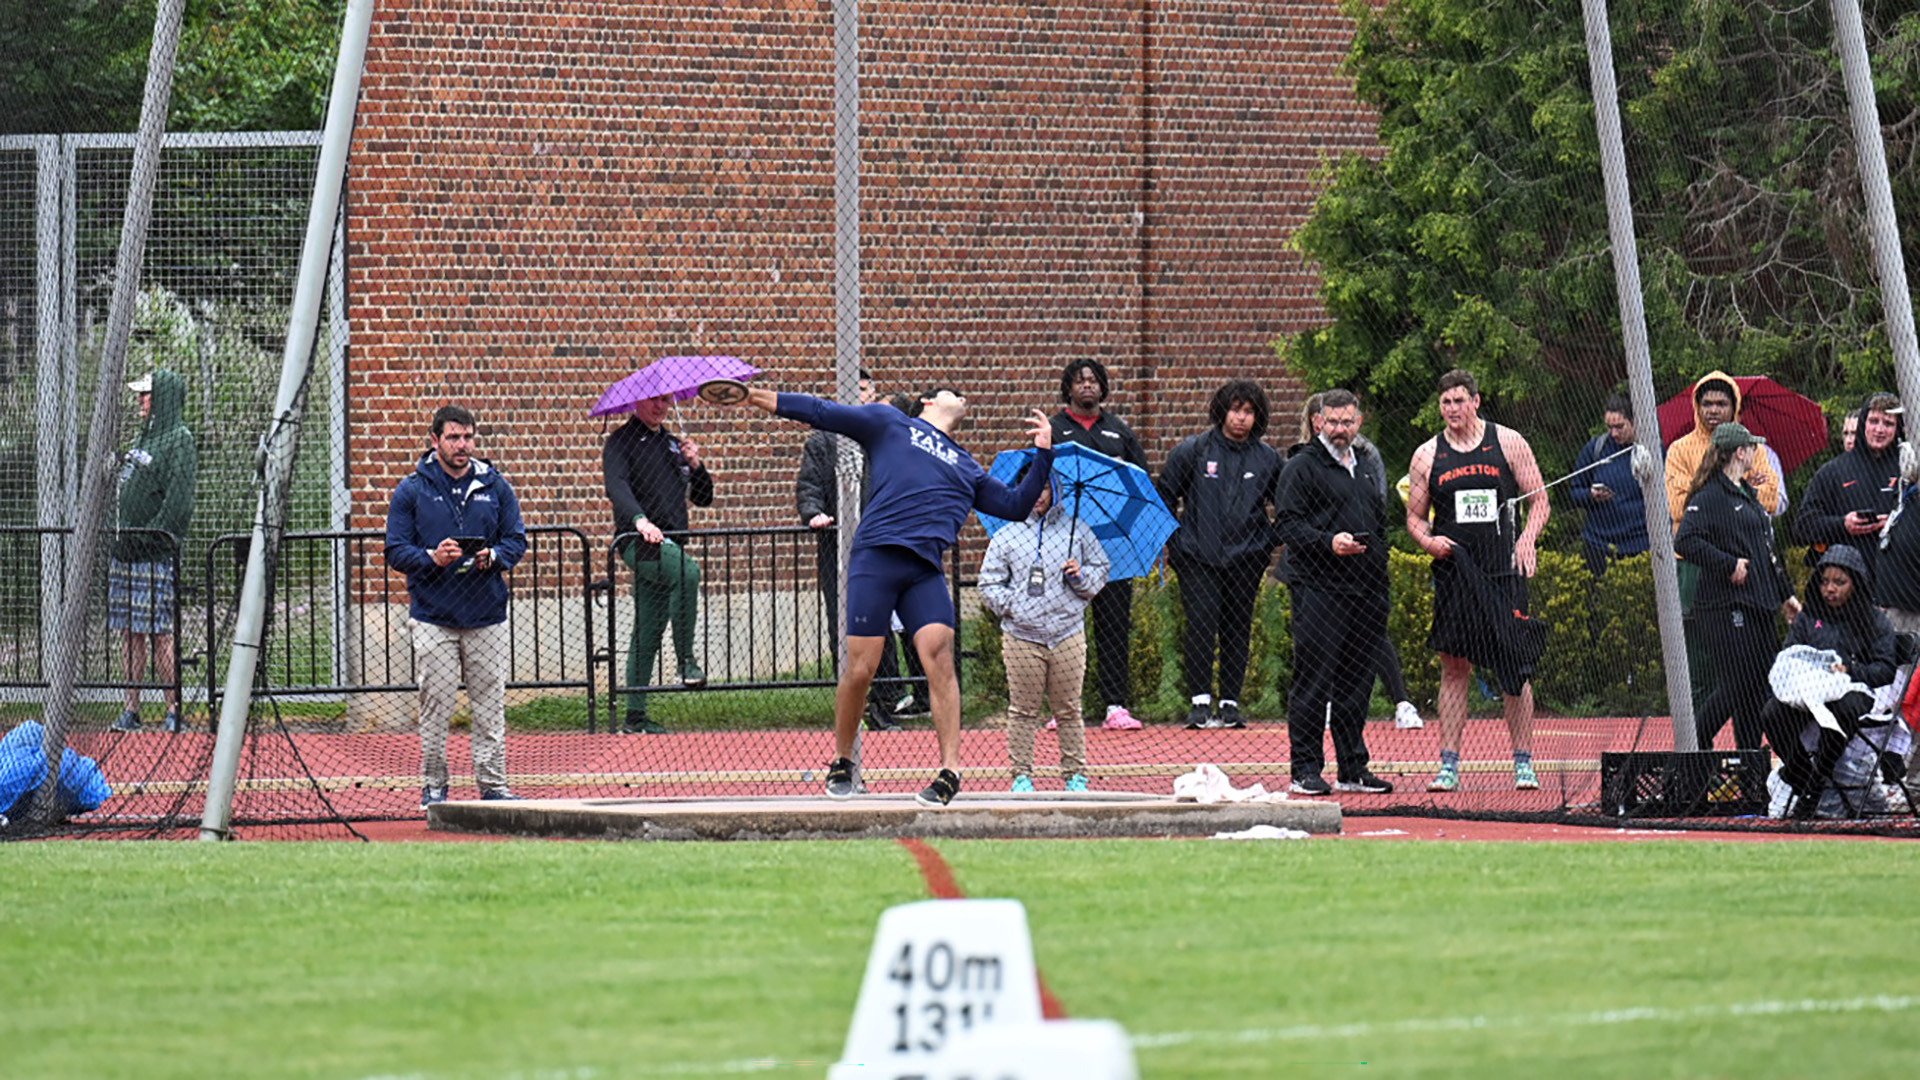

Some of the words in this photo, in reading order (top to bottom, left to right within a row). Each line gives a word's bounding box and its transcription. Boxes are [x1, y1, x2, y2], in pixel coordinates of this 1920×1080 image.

[909, 426, 960, 463] YALE
[1438, 464, 1501, 486] PRINCETON
[1464, 503, 1488, 518] 443
[889, 941, 1003, 992] 40m
